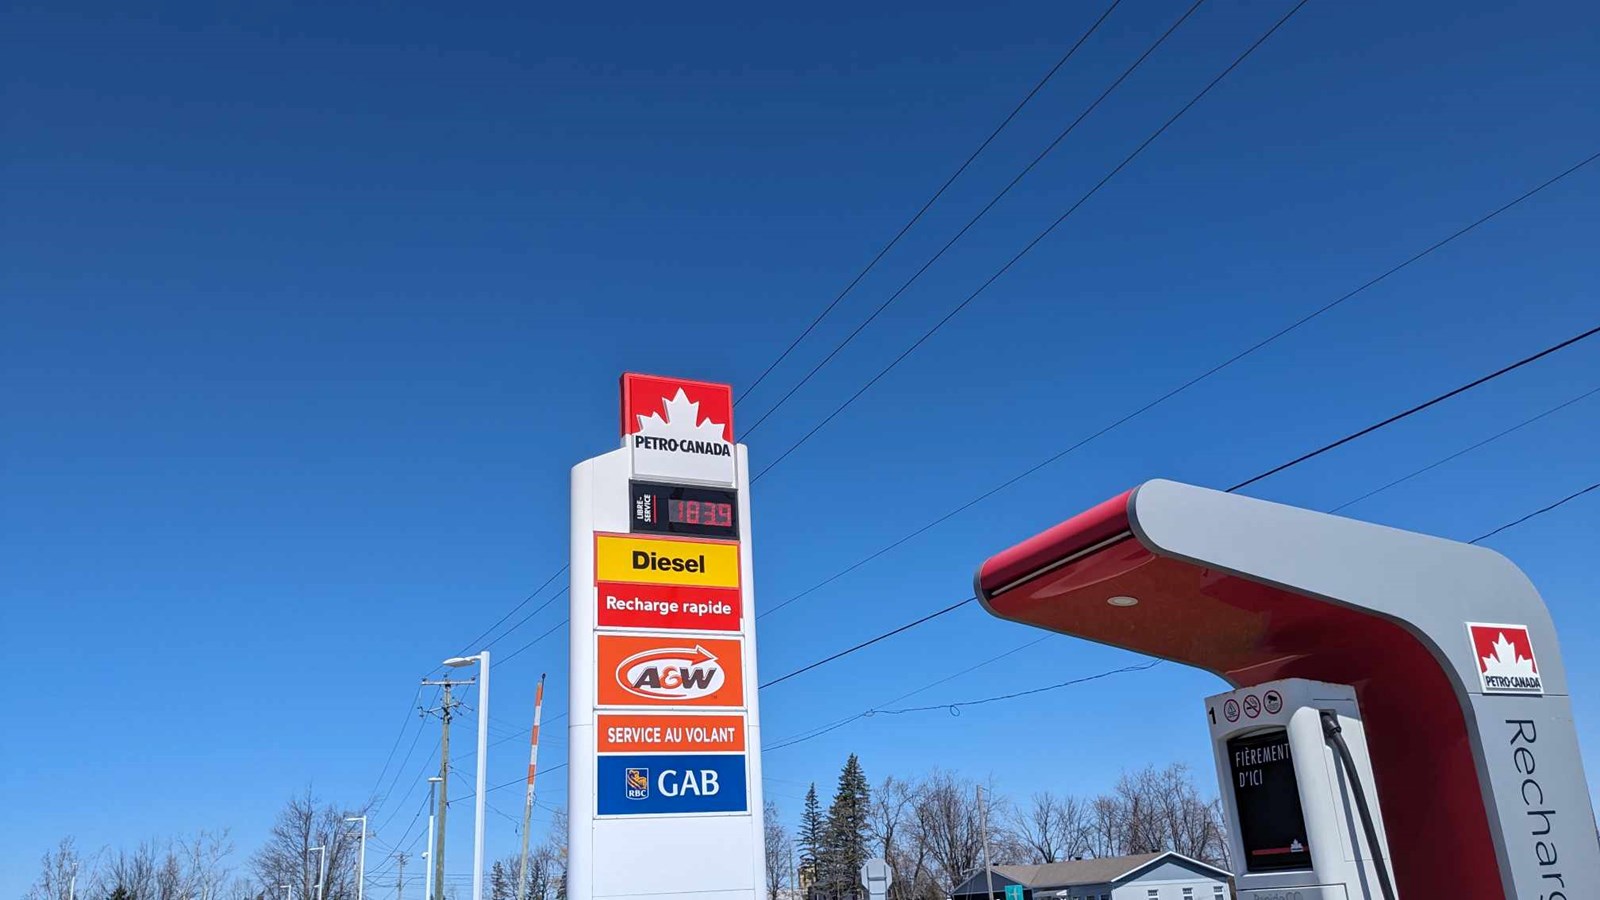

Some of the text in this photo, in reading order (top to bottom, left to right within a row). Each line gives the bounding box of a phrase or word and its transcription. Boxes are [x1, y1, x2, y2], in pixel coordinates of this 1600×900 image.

[632, 550, 705, 573] Diesel
[606, 596, 732, 616] Recharge rapide
[632, 666, 717, 690] A&W
[1209, 707, 1216, 724] 1
[608, 727, 735, 743] SERVICE AU VOLANT
[1235, 743, 1290, 767] FIÈREMENT
[628, 790, 646, 798] RBC
[657, 770, 720, 797] GAB
